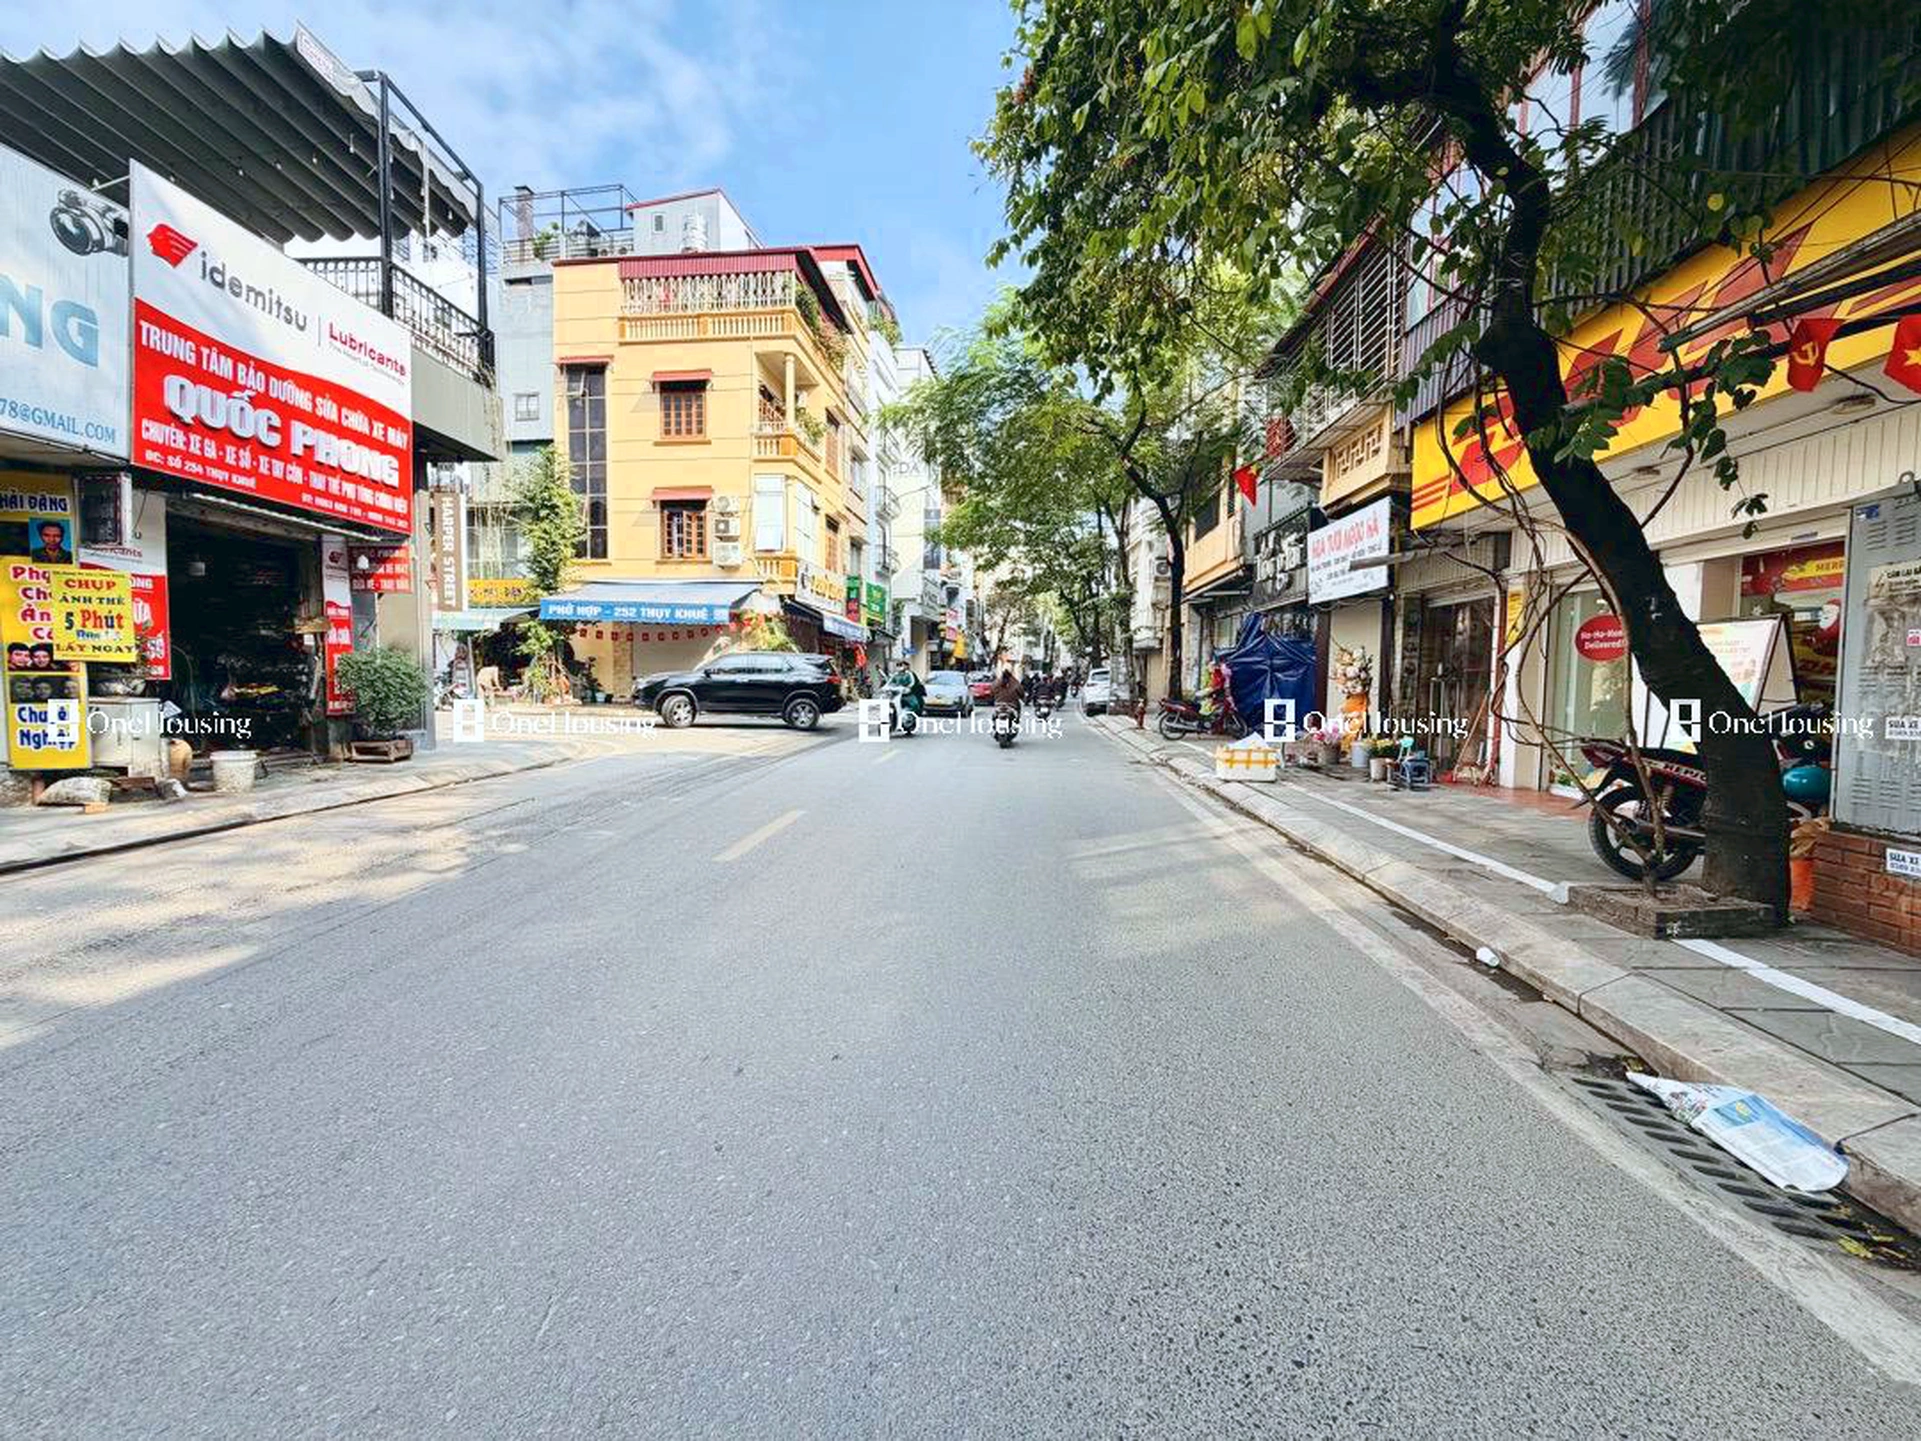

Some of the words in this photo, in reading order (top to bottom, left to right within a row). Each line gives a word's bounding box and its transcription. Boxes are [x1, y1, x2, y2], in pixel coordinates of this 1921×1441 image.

[200, 251, 308, 332] idemitsu
[328, 322, 407, 377] Lubricants
[139, 319, 197, 367] TRUNG
[200, 346, 234, 382] TÂM
[237, 360, 265, 393] BẢO
[371, 419, 386, 441] XE
[163, 374, 282, 449] QUỐC
[290, 419, 399, 489] PHONG
[440, 497, 455, 552] HARPER
[21, 587, 52, 600] Ch
[64, 579, 117, 591] CHỤP
[443, 556, 457, 608] STREET
[65, 611, 75, 630] 5
[80, 609, 125, 630] Phút
[613, 605, 637, 618] 252
[55, 641, 87, 654] LẤY
[91, 645, 134, 654] NGAY
